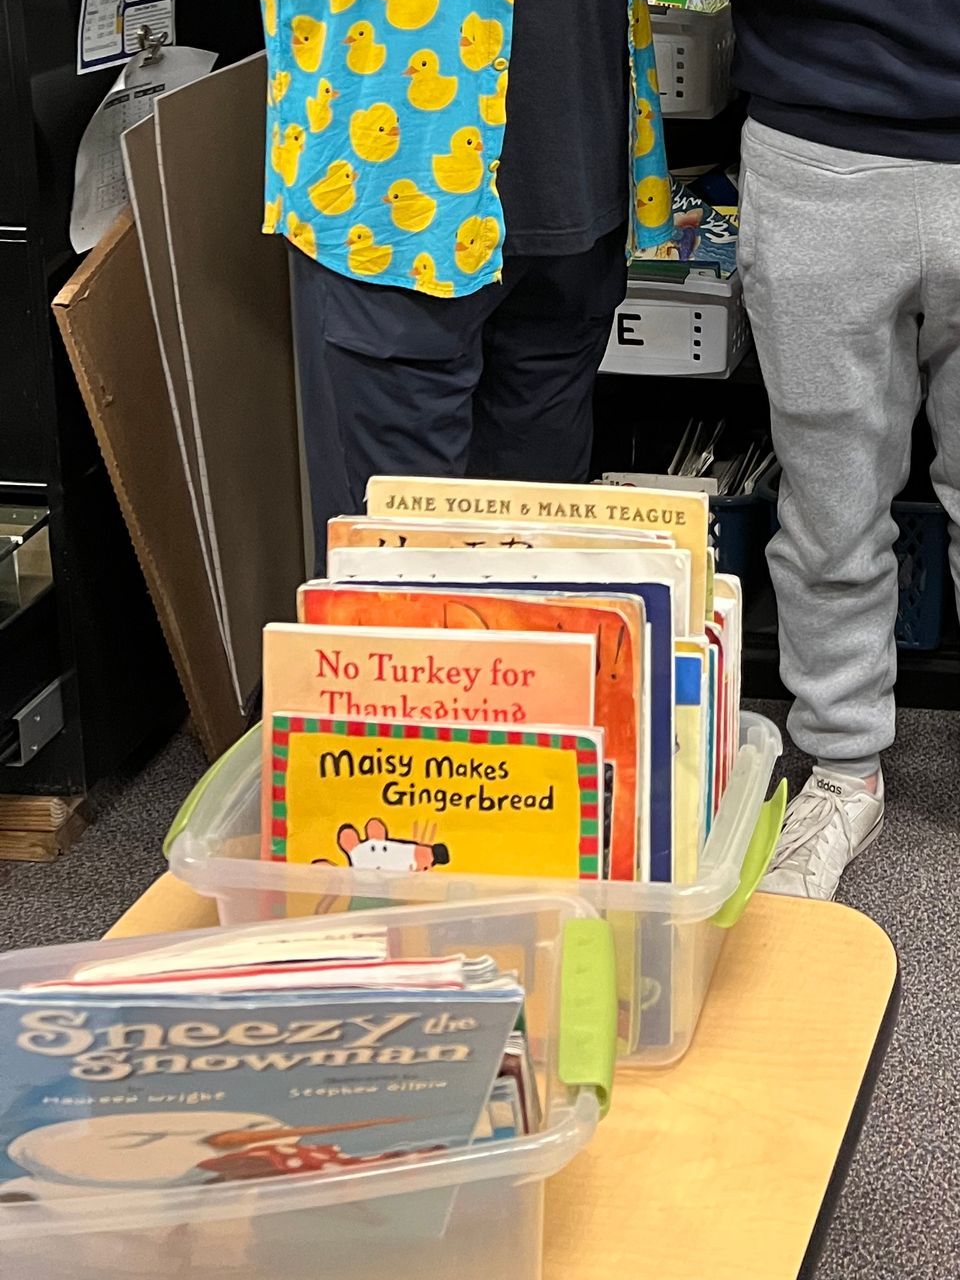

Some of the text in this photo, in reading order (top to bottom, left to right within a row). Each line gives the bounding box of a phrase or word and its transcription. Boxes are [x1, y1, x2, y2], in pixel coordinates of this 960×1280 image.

[617, 312, 645, 346] E
[385, 495, 688, 526] JANE YOLEN & MARK TEAGUE
[316, 649, 536, 693] No Turkey for
[319, 747, 509, 781] Maisy Makes
[382, 780, 555, 813] Gingerbread
[17, 1007, 477, 1058] Sneezy the
[70, 1042, 472, 1082] Snowman
